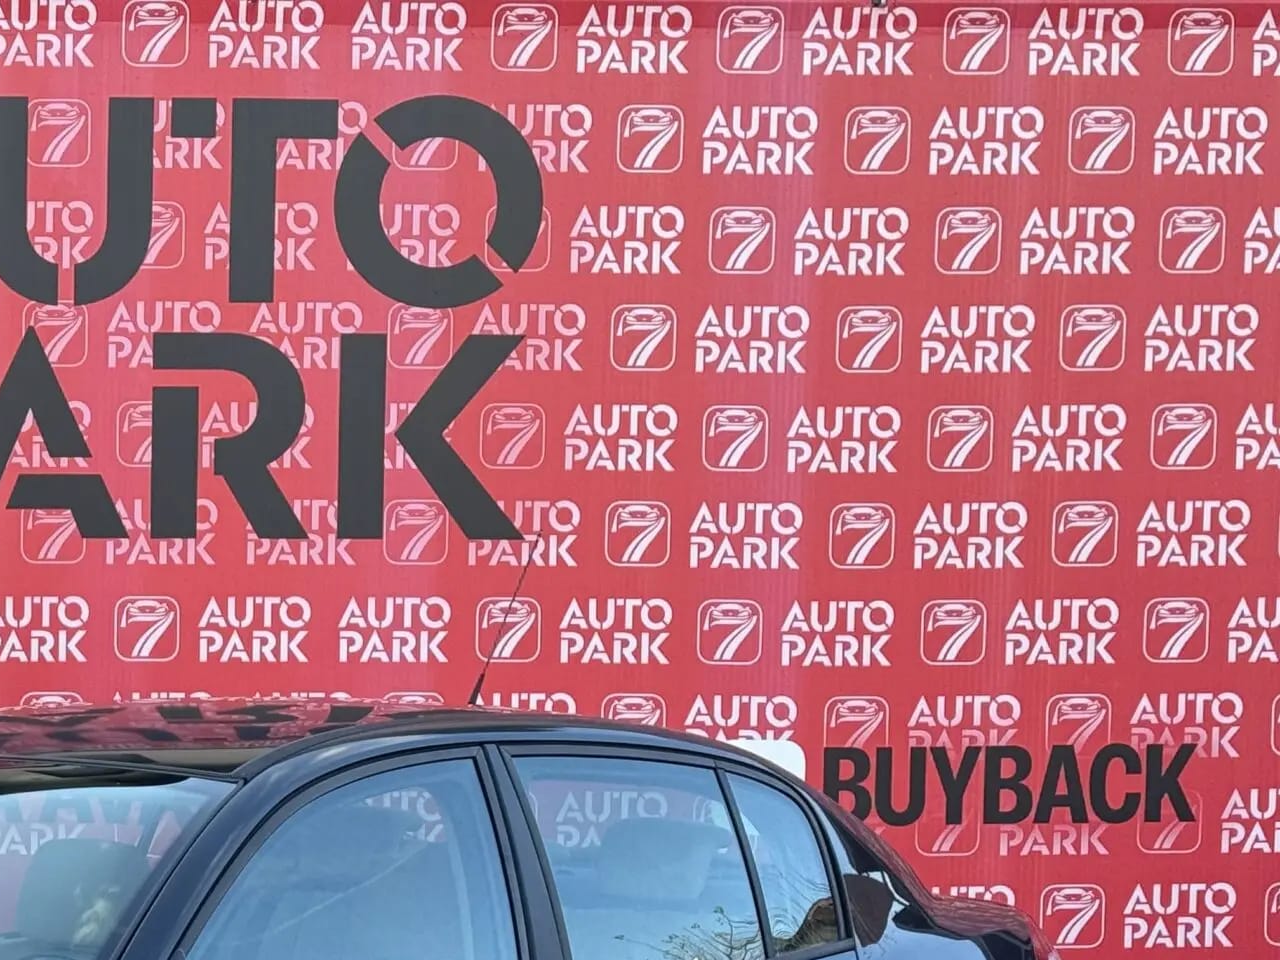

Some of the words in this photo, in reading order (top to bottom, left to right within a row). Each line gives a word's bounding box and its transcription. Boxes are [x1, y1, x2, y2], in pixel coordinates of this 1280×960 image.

[207, 0, 324, 34] AUTO
[351, 2, 467, 36] AUTO
[575, 5, 693, 38] AUTO
[801, 6, 917, 40] AUTO
[1028, 7, 1144, 41] AUTO
[209, 34, 321, 70] PARK
[351, 36, 463, 71] PARK
[576, 39, 689, 74] PARK
[802, 41, 914, 76] PARK
[1028, 42, 1141, 76] PARK
[702, 105, 818, 140] AUTO
[928, 105, 1044, 140] AUTO
[1153, 106, 1268, 140] AUTO
[702, 140, 815, 176] PARK
[928, 141, 1041, 176] PARK
[1153, 141, 1265, 175] PARK
[569, 205, 685, 239] AUTO
[793, 206, 909, 241] AUTO
[1019, 206, 1135, 240] AUTO
[570, 240, 681, 274] PARK
[793, 242, 906, 276] PARK
[1019, 241, 1132, 275] PARK
[107, 300, 221, 333] AUTO
[249, 301, 363, 334] AUTO
[471, 303, 586, 336] AUTO
[694, 305, 810, 339] AUTO
[920, 304, 1036, 339] AUTO
[1144, 303, 1259, 337] AUTO
[695, 339, 807, 374] PARK
[920, 339, 1032, 374] PARK
[1144, 338, 1256, 372] PARK
[563, 404, 678, 437] AUTO
[786, 405, 901, 439] AUTO
[1011, 403, 1127, 437] AUTO
[564, 438, 675, 472] PARK
[787, 440, 898, 473] PARK
[1012, 438, 1123, 473] PARK
[689, 502, 803, 535] AUTO
[913, 501, 1028, 535] AUTO
[1136, 499, 1251, 533] AUTO
[106, 533, 215, 565] PARK
[246, 533, 355, 565] PARK
[468, 534, 577, 567] PARK
[689, 535, 800, 570] PARK
[913, 535, 1024, 569] PARK
[1136, 533, 1247, 567] PARK
[198, 595, 312, 629] AUTO
[338, 596, 451, 629] AUTO
[559, 597, 673, 631] AUTO
[780, 600, 895, 633] AUTO
[1005, 597, 1119, 631] AUTO
[199, 629, 309, 663] PARK
[339, 630, 449, 663] PARK
[560, 631, 670, 665] PARK
[781, 634, 891, 667] PARK
[1005, 631, 1116, 666] PARK
[684, 694, 798, 728] AUTO
[907, 694, 1021, 727] AUTO
[1130, 692, 1243, 724] AUTO
[823, 743, 1197, 826] BUYBACK
[999, 825, 1110, 857] PARK
[1123, 882, 1237, 915] AUTO
[1124, 916, 1233, 948] PARK
